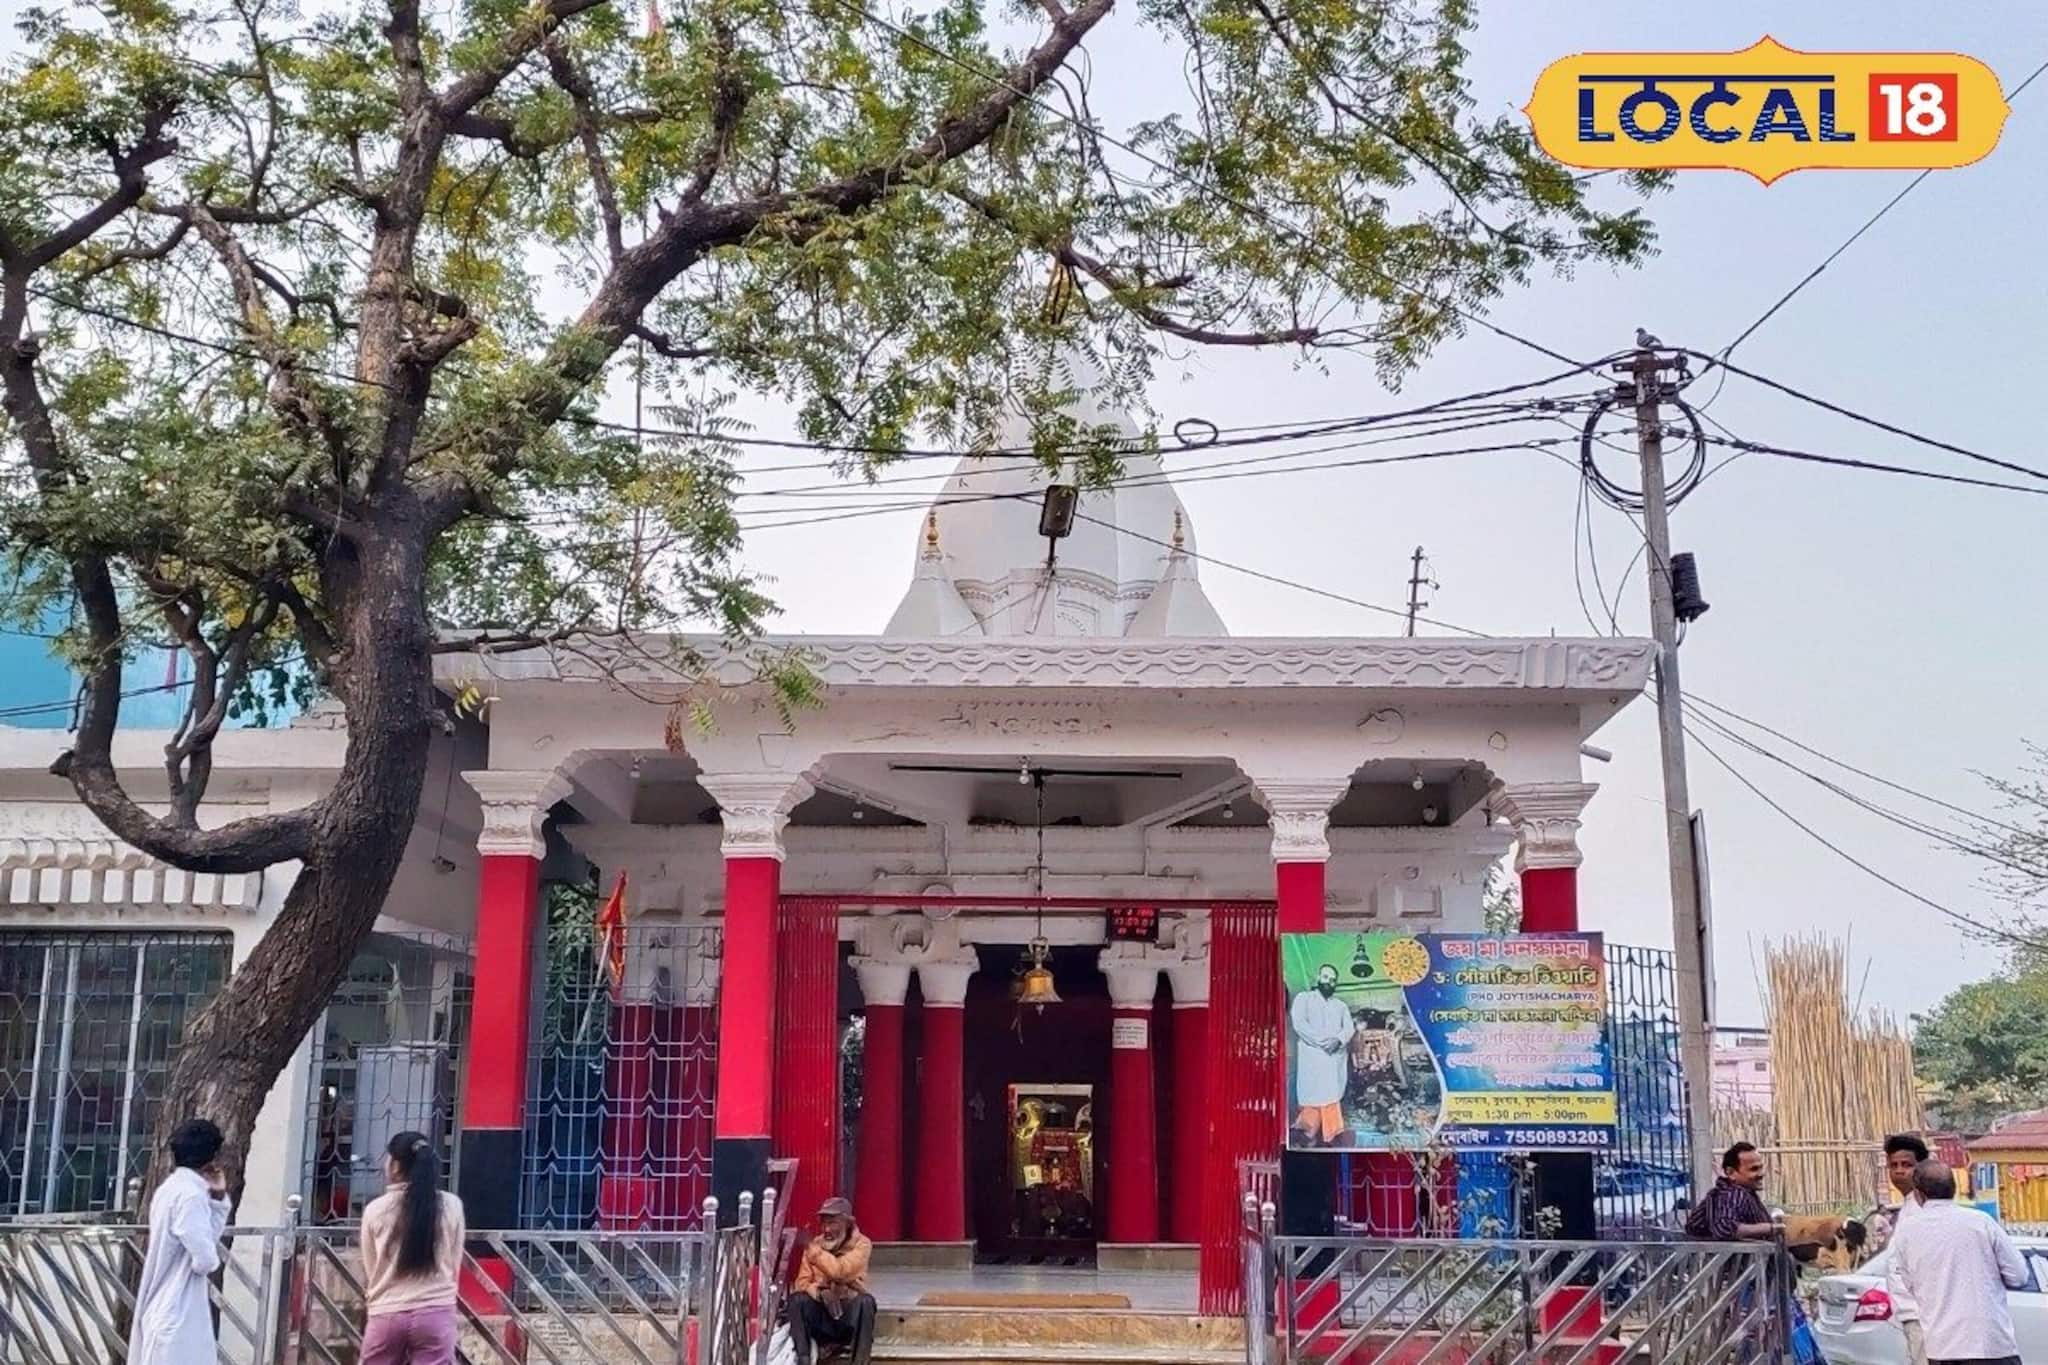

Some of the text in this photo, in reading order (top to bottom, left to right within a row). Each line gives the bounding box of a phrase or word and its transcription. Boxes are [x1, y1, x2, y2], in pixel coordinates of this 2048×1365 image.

[1477, 940, 1499, 959] মা
[1496, 991, 1599, 1001] JOYTISHACHARYA)
[1485, 1110, 1509, 1120] 1:30
[1513, 1112, 1532, 1122] pm
[1504, 1130, 1609, 1144] 7550893203
